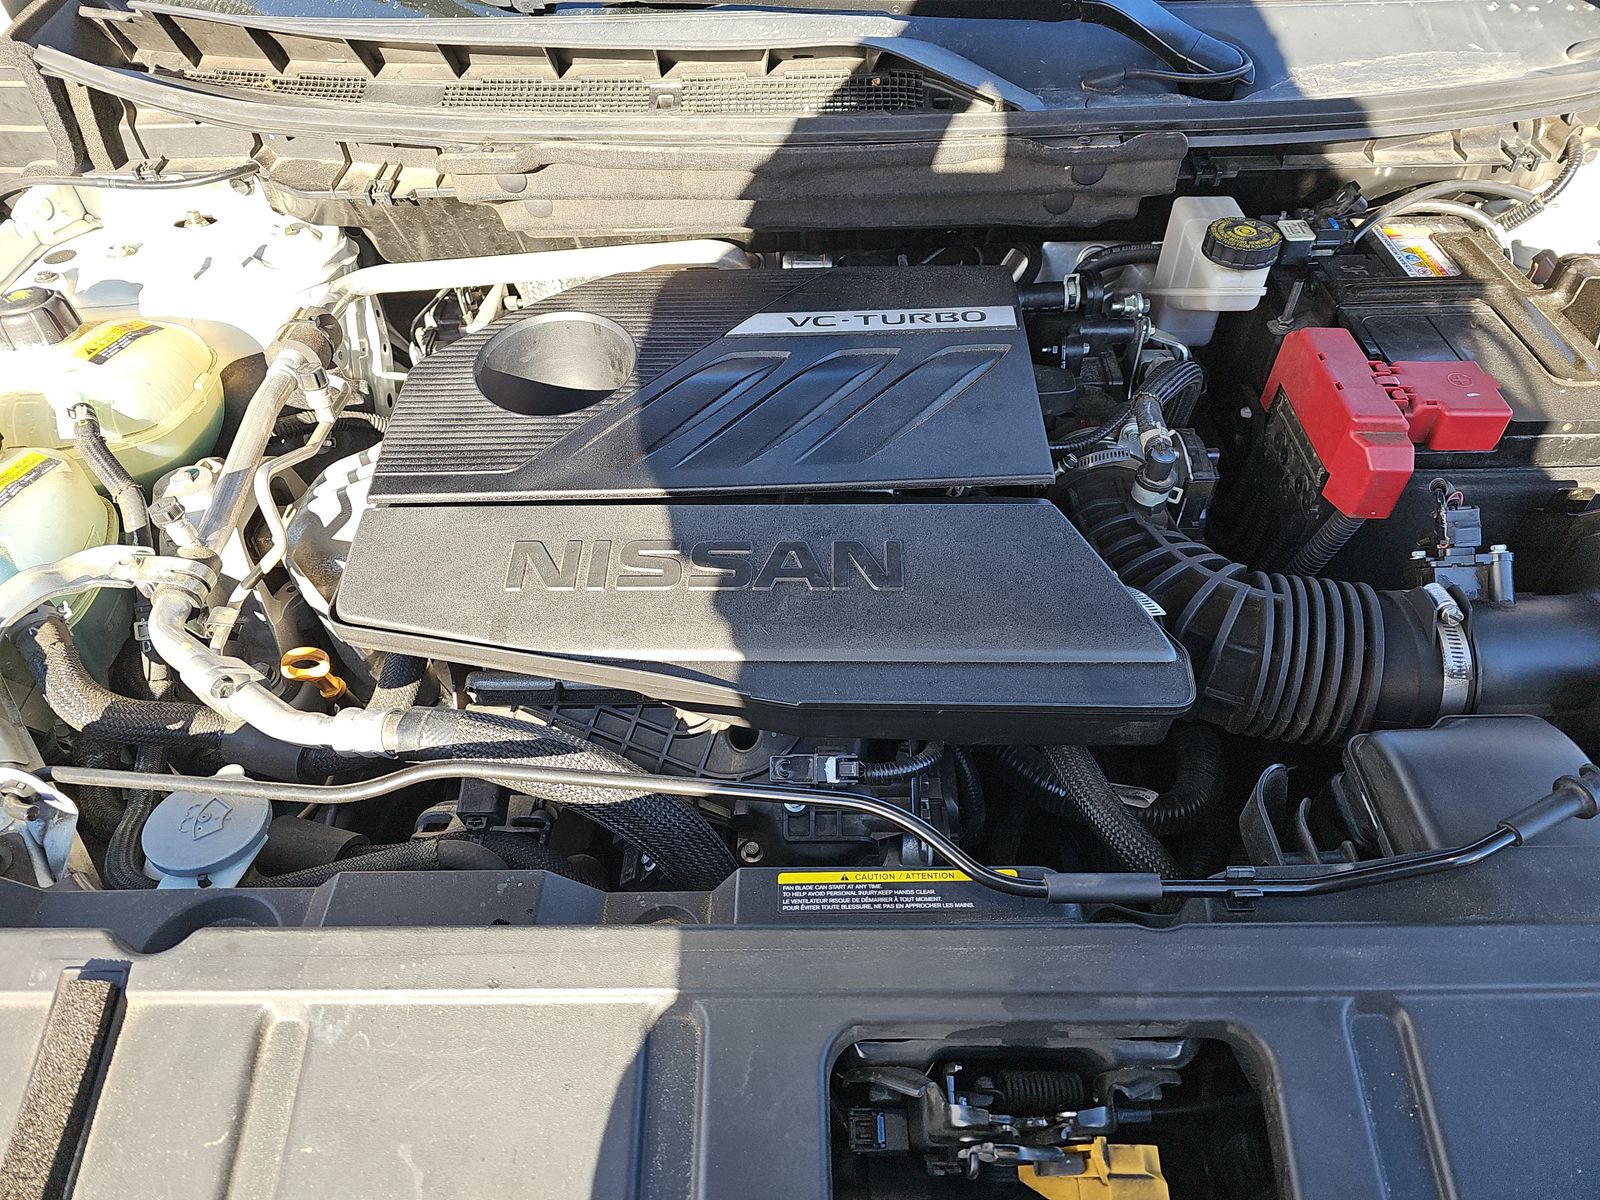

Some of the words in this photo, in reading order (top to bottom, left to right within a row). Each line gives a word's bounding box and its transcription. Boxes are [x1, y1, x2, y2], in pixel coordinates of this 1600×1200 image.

[786, 310, 987, 327] VC-TURBO
[505, 539, 903, 591] NISSAN
[906, 872, 955, 880] ATTENTION
